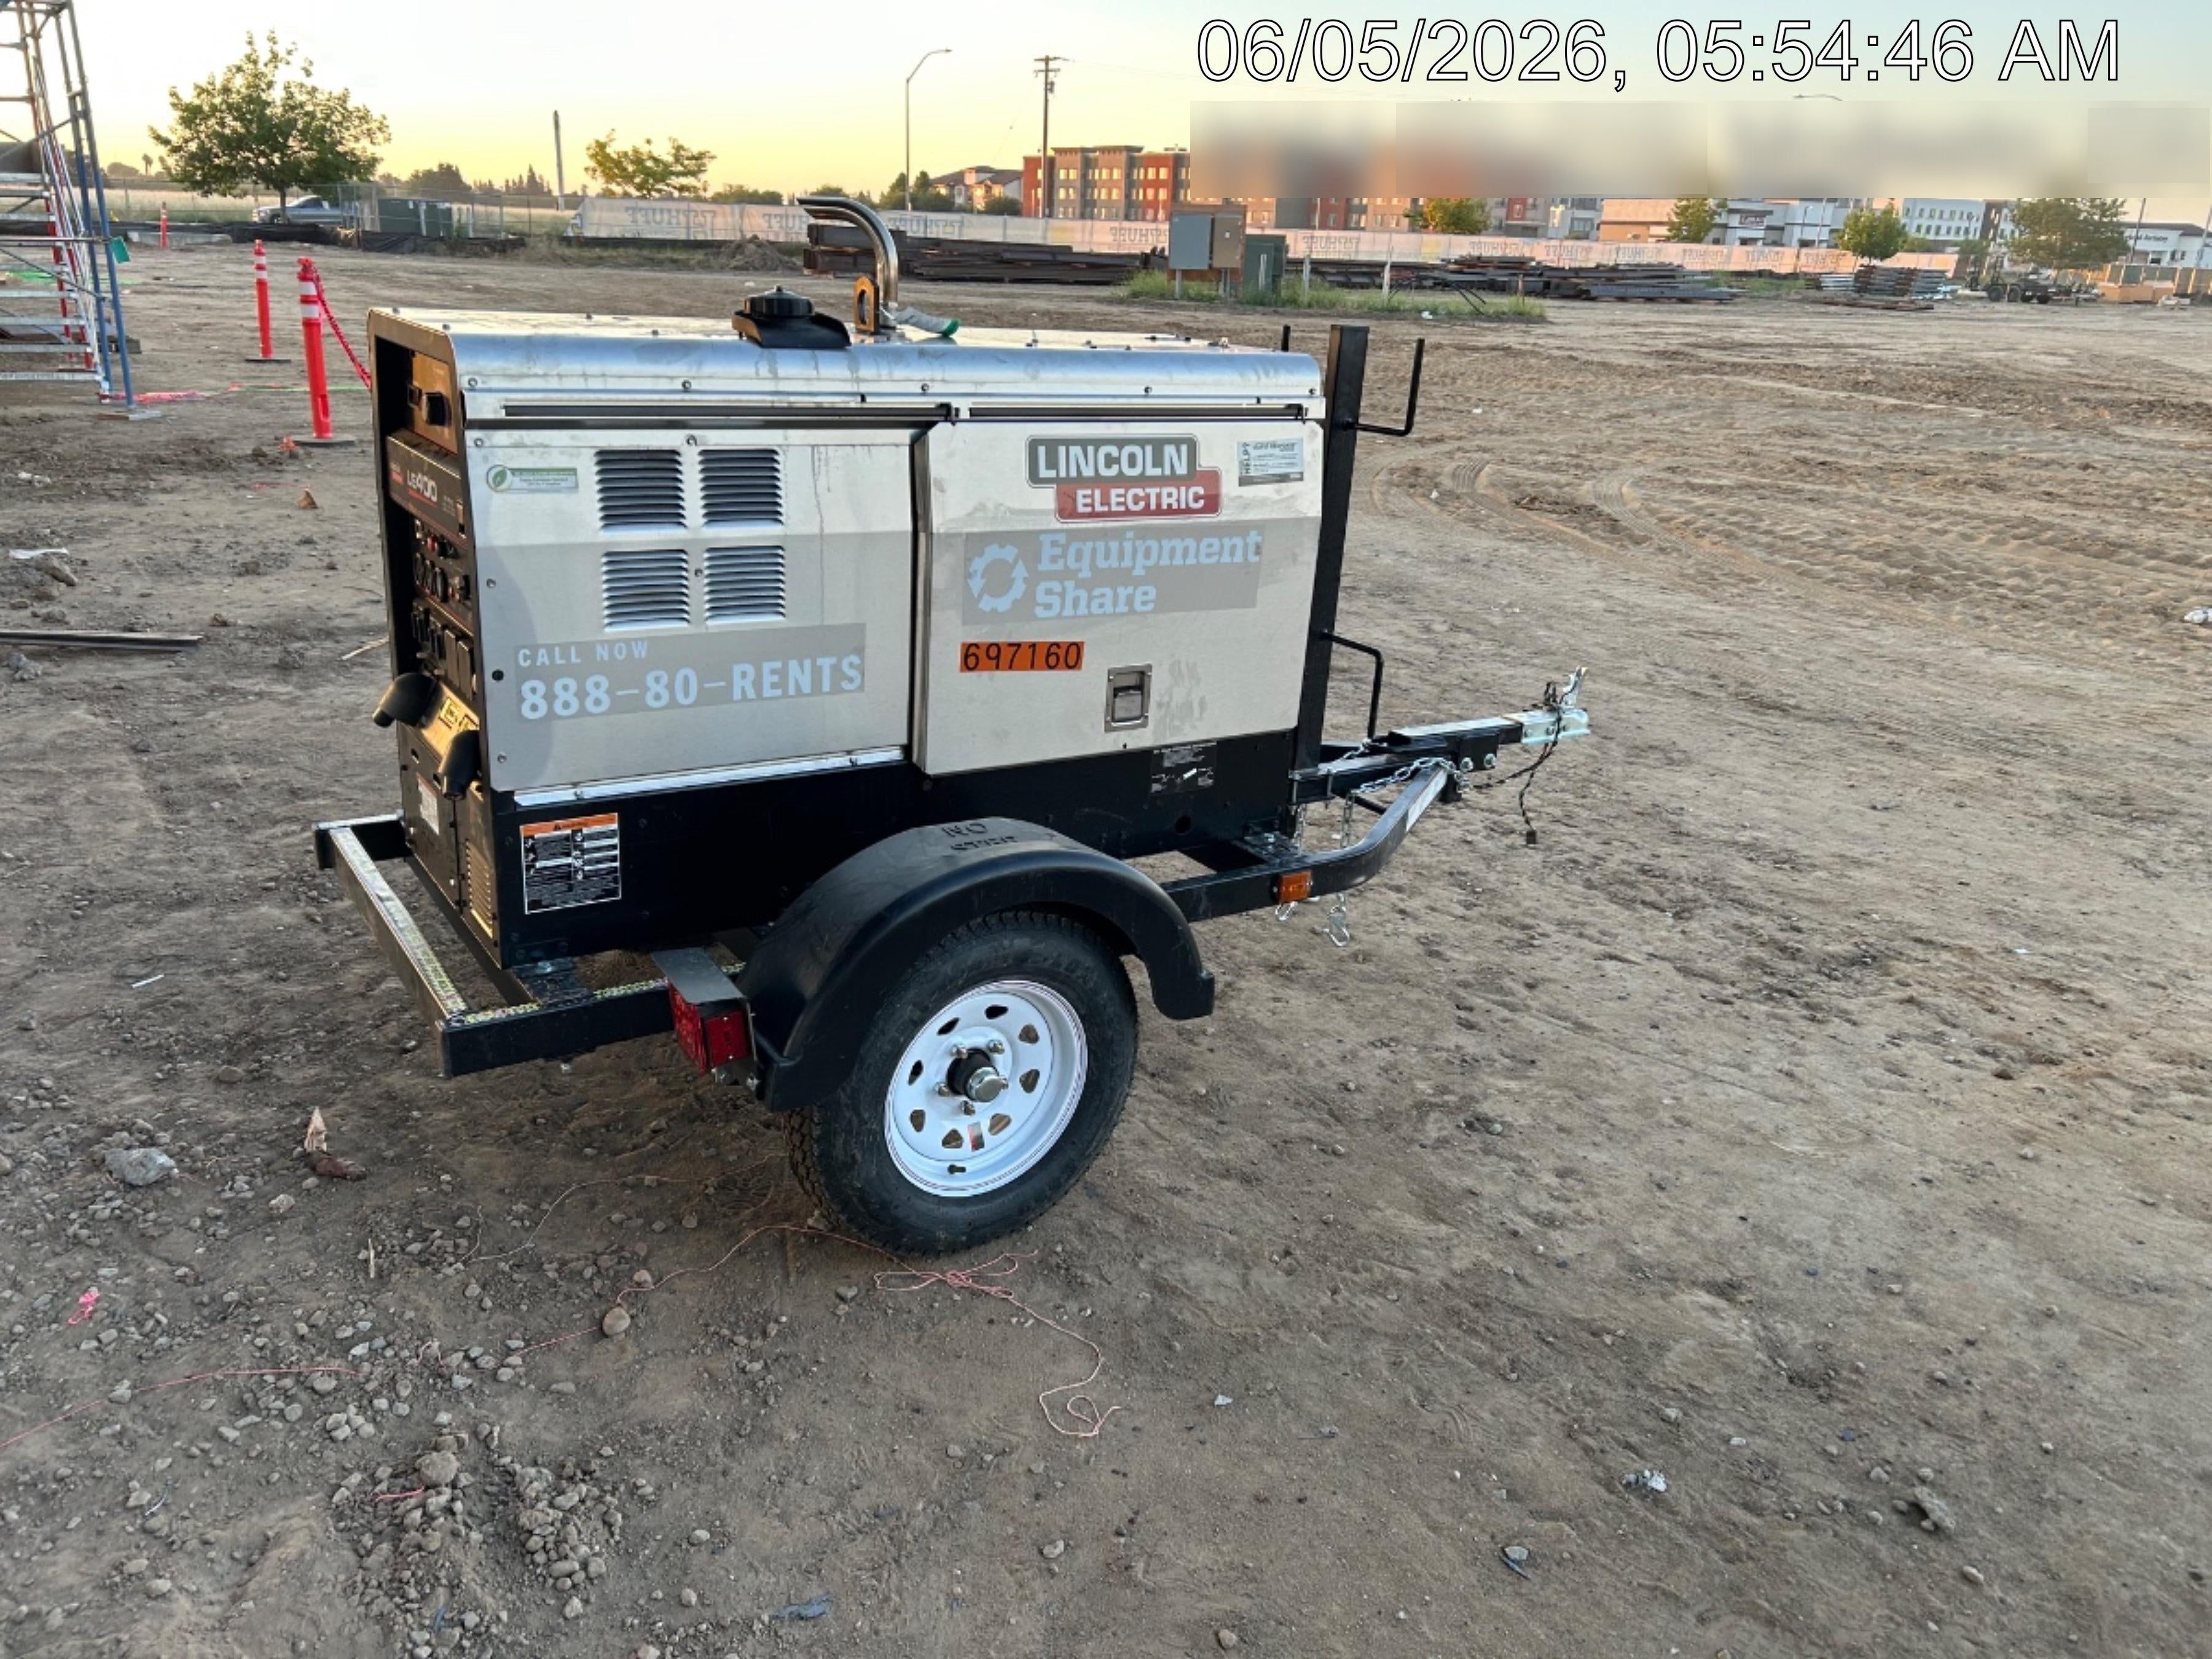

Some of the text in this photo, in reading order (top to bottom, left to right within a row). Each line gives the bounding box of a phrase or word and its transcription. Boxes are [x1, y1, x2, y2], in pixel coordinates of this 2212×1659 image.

[1038, 443, 1188, 479] LINCOLN
[1076, 485, 1205, 514] ELECTRIC
[1038, 530, 1262, 575] Equipment
[1034, 580, 1156, 619] Share
[518, 641, 648, 667] CALL NOW
[963, 642, 1083, 670] 697160
[520, 654, 861, 720] 888-80-RENTS
